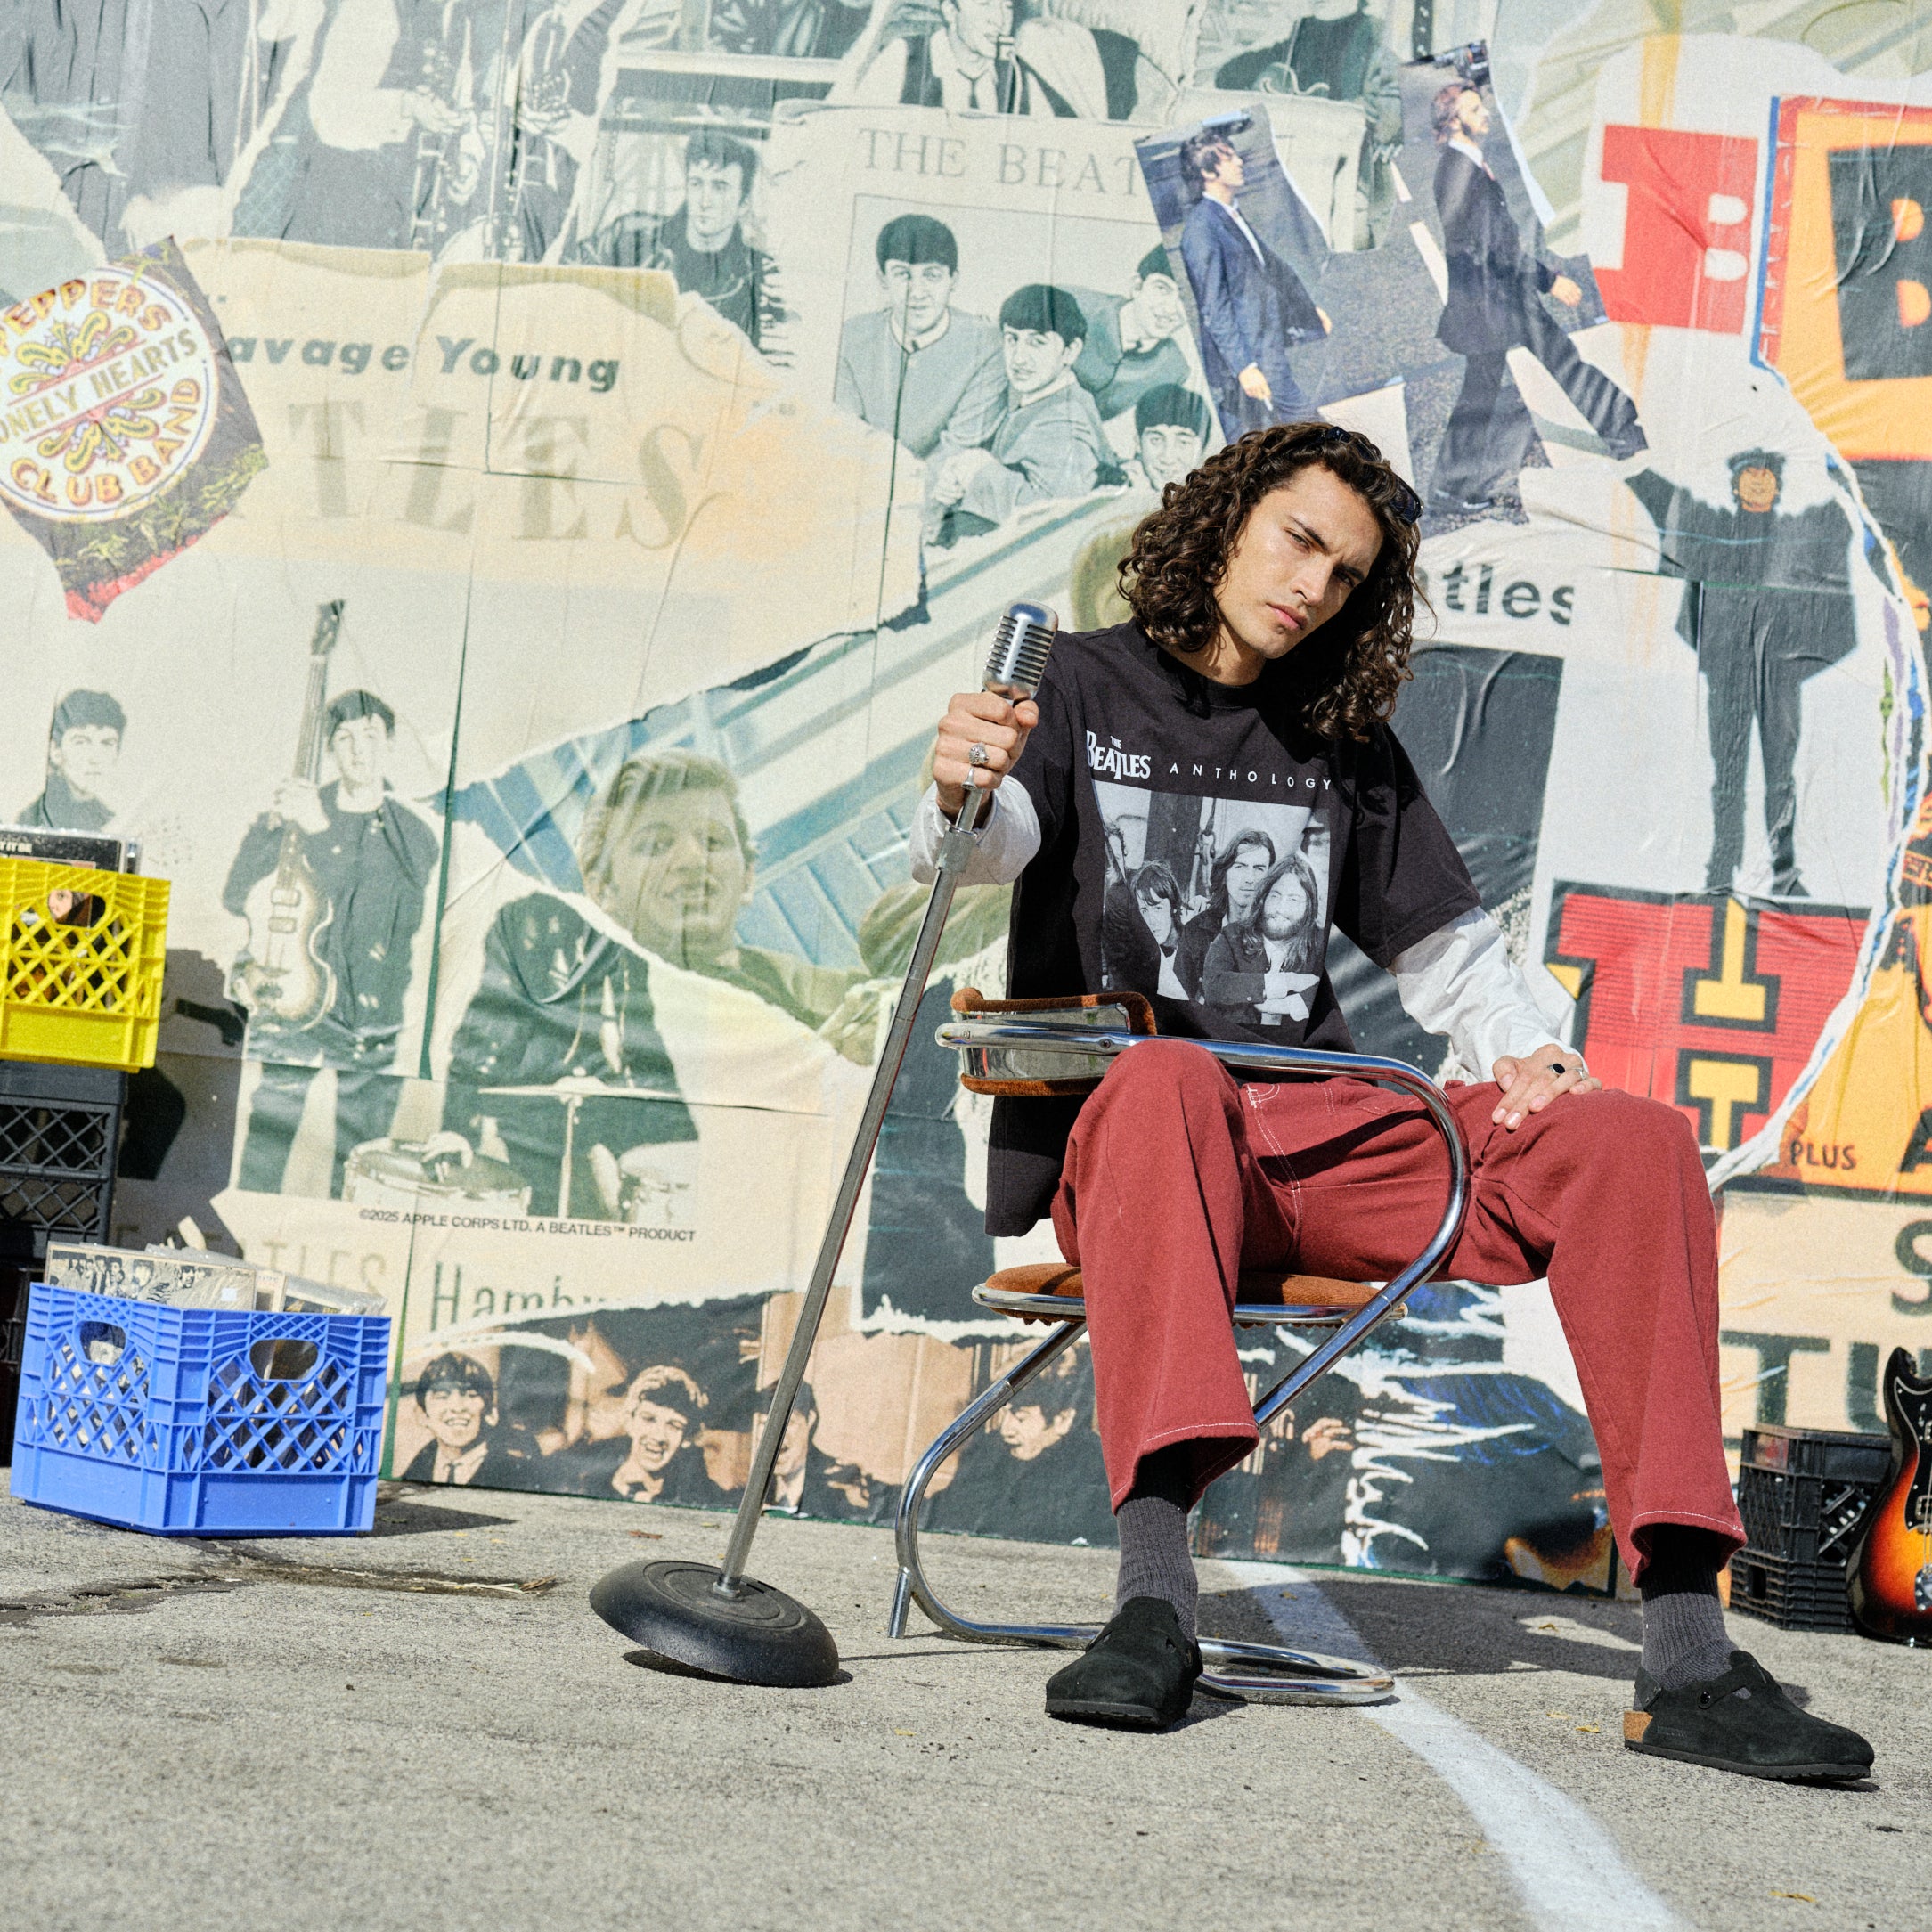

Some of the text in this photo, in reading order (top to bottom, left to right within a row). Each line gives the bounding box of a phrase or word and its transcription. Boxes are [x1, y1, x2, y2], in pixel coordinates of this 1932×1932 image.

[859, 127, 1137, 197] THE BEAT
[90, 328, 199, 399] HEARTS
[226, 335, 621, 393] avage Young
[127, 378, 200, 486] BAND
[10, 458, 123, 507] CLUB
[1086, 730, 1332, 791] BEATLES ANTHOLOGY
[1110, 735, 1122, 750] THE
[1789, 1138, 1857, 1171] PLUS
[402, 1212, 449, 1227] APPLE
[451, 1215, 501, 1230] CORPS
[502, 1219, 533, 1233] LTD.
[535, 1221, 546, 1233] A
[628, 1226, 697, 1242] PRODUCT
[430, 1260, 622, 1332] Hamb
